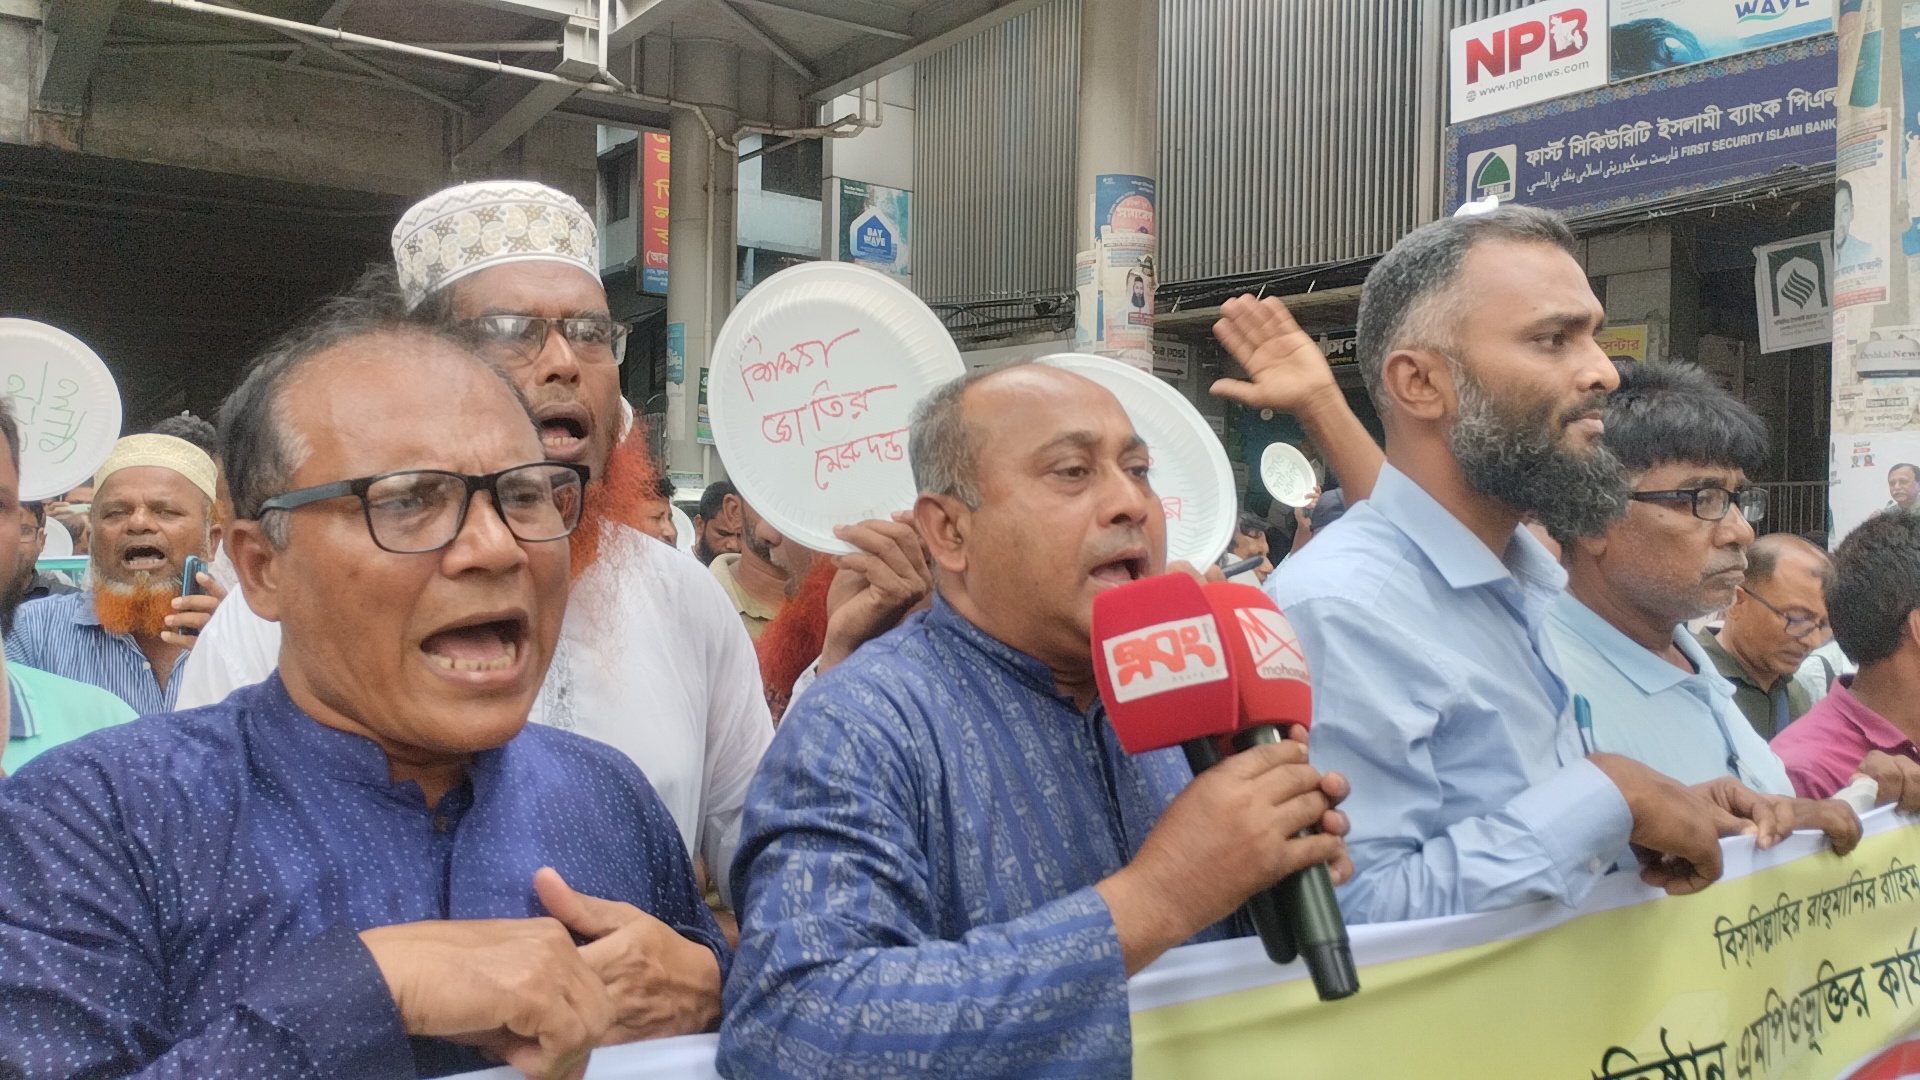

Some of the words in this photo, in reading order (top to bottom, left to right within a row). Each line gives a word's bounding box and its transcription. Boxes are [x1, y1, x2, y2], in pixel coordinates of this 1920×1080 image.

[1465, 8, 1588, 85] NPB
[1479, 60, 1590, 98] www.npbnews.com
[1525, 138, 1566, 168] ফার্স্ট
[1568, 121, 1652, 160] সিকিউরিটি
[1657, 104, 1724, 141] ইসলামী
[1728, 96, 1782, 127] ব্যাংক
[1681, 141, 1710, 158] FIRST
[1712, 132, 1763, 152] SECURITY
[1766, 124, 1803, 142] ISLAMI
[1805, 117, 1837, 135] BANK
